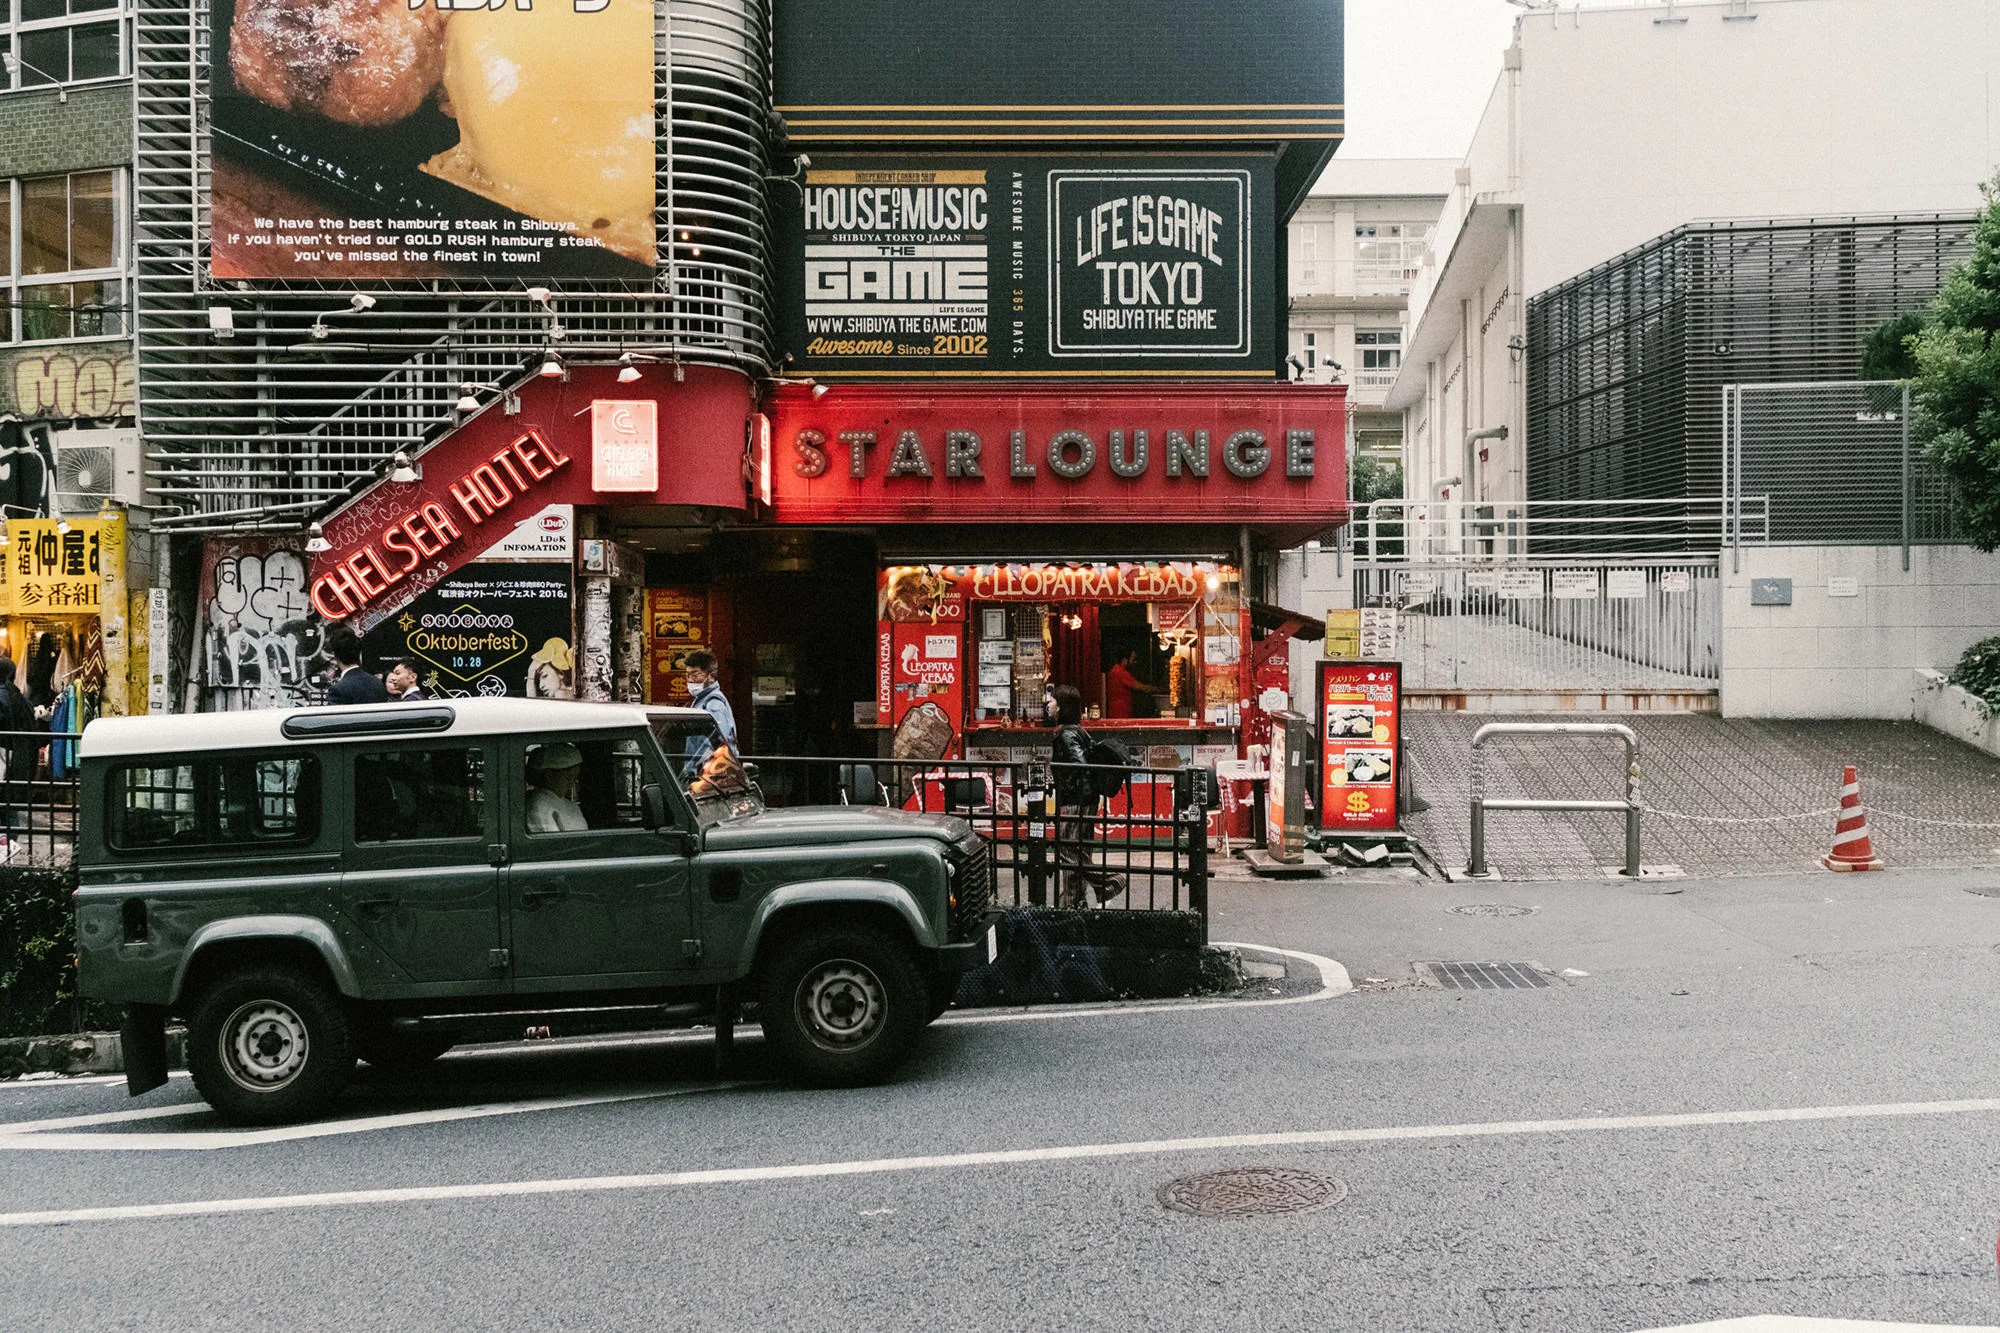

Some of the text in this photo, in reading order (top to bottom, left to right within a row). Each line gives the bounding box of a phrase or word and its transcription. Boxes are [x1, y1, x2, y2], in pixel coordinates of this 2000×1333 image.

[805, 187, 988, 230] HOUSE OF MUSIC
[254, 217, 580, 231] We have the best hamburg steak in Shibuya.
[1077, 195, 1223, 267] LIFE IS GAME
[228, 233, 607, 248] If you haven't tried our GOLD RUSH hamburg steak,
[832, 233, 961, 244] SHIBUYA TOKYO JAPAN
[294, 250, 541, 263] you've missed the finest in town!
[877, 246, 915, 256] THE
[1012, 171, 1024, 359] AWESOME MUSIC 365 DAYS.
[805, 261, 987, 300] GAME
[1096, 261, 1202, 305] TOKYO
[898, 317, 920, 333] THE
[923, 317, 987, 333] GAME.COM
[1083, 309, 1218, 330] SHIBUYA THE GAME
[806, 335, 988, 356] Awesome Since 2002
[793, 428, 986, 479] STAR
[1009, 428, 1316, 479] LOUNGE
[310, 500, 463, 621] CHELSEA
[448, 428, 573, 527] HOTEL
[540, 535, 567, 543] LD&K
[18, 530, 31, 576] 元祖
[974, 569, 1198, 598] CLEOPATRA KEBAB
[421, 614, 514, 629] SHIBUYA
[415, 633, 518, 651] Oktoberfest
[879, 632, 891, 713] CLEOPATRA KEBAB
[902, 655, 955, 676] CLEOPATRA
[921, 672, 955, 684] KEBAB
[1378, 672, 1393, 681] 4F
